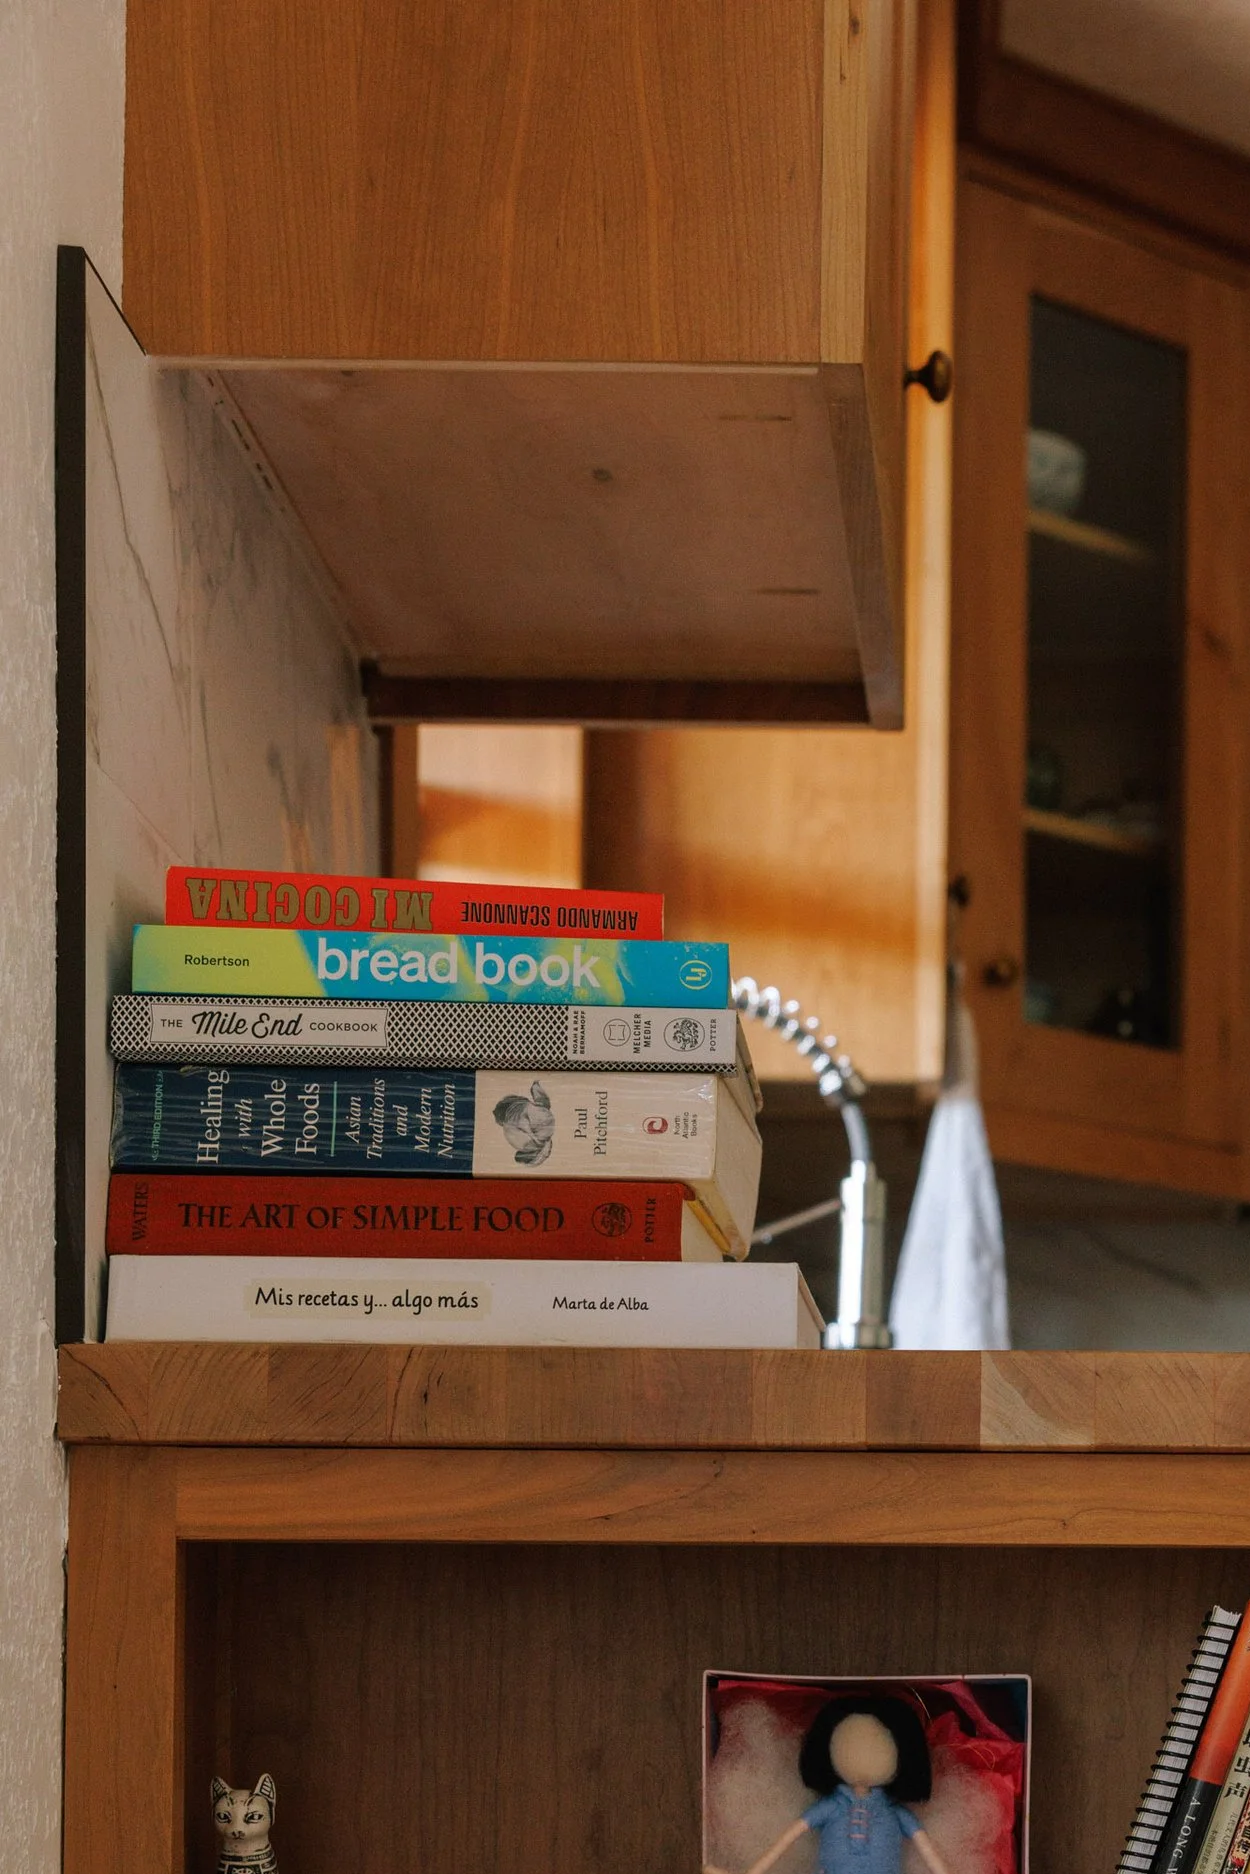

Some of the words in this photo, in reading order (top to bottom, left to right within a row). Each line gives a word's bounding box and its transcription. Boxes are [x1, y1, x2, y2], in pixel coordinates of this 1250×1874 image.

[186, 877, 360, 926] COCINA
[370, 887, 434, 931] MI
[461, 901, 550, 925] SCANNONE
[556, 906, 638, 931] ARMANDO
[184, 954, 250, 967] Robertson
[317, 937, 458, 983] bread
[475, 942, 600, 987] book
[161, 1019, 183, 1028] THE
[191, 1011, 248, 1037] Mile
[251, 1013, 303, 1039] End
[309, 1022, 378, 1032] COOKBOOK
[633, 1013, 642, 1054] MELCHER
[643, 1020, 651, 1048] MEDIA
[709, 1018, 717, 1052] POTTER
[197, 1069, 230, 1164] Healing
[239, 1096, 253, 1138] with
[261, 1079, 287, 1158] Whole
[295, 1082, 320, 1155] Foods
[344, 1096, 361, 1143] Asian
[367, 1078, 386, 1159] Traditions
[393, 1103, 408, 1137] and
[414, 1087, 432, 1154] Modern
[437, 1083, 455, 1158] Nutrition
[574, 1108, 588, 1139] Paul
[593, 1091, 608, 1156] Pitchford
[673, 1115, 681, 1135] North
[682, 1111, 690, 1139] Atlantic
[132, 1183, 149, 1241] WATERS
[178, 1203, 233, 1228] THE
[240, 1203, 300, 1229] ART
[305, 1205, 345, 1230] OF
[352, 1204, 463, 1231] SIMPLE
[472, 1206, 565, 1232] FOOD
[645, 1197, 657, 1243] POTTER
[255, 1287, 293, 1306] Mis
[298, 1290, 359, 1307] recetas
[364, 1293, 387, 1314] y...
[392, 1290, 433, 1314] algo
[437, 1290, 479, 1308] más
[552, 1296, 597, 1311] Marta
[600, 1297, 614, 1311] de
[616, 1298, 649, 1311] Alba
[1190, 1797, 1200, 1807] A
[1172, 1815, 1196, 1859] LONG
